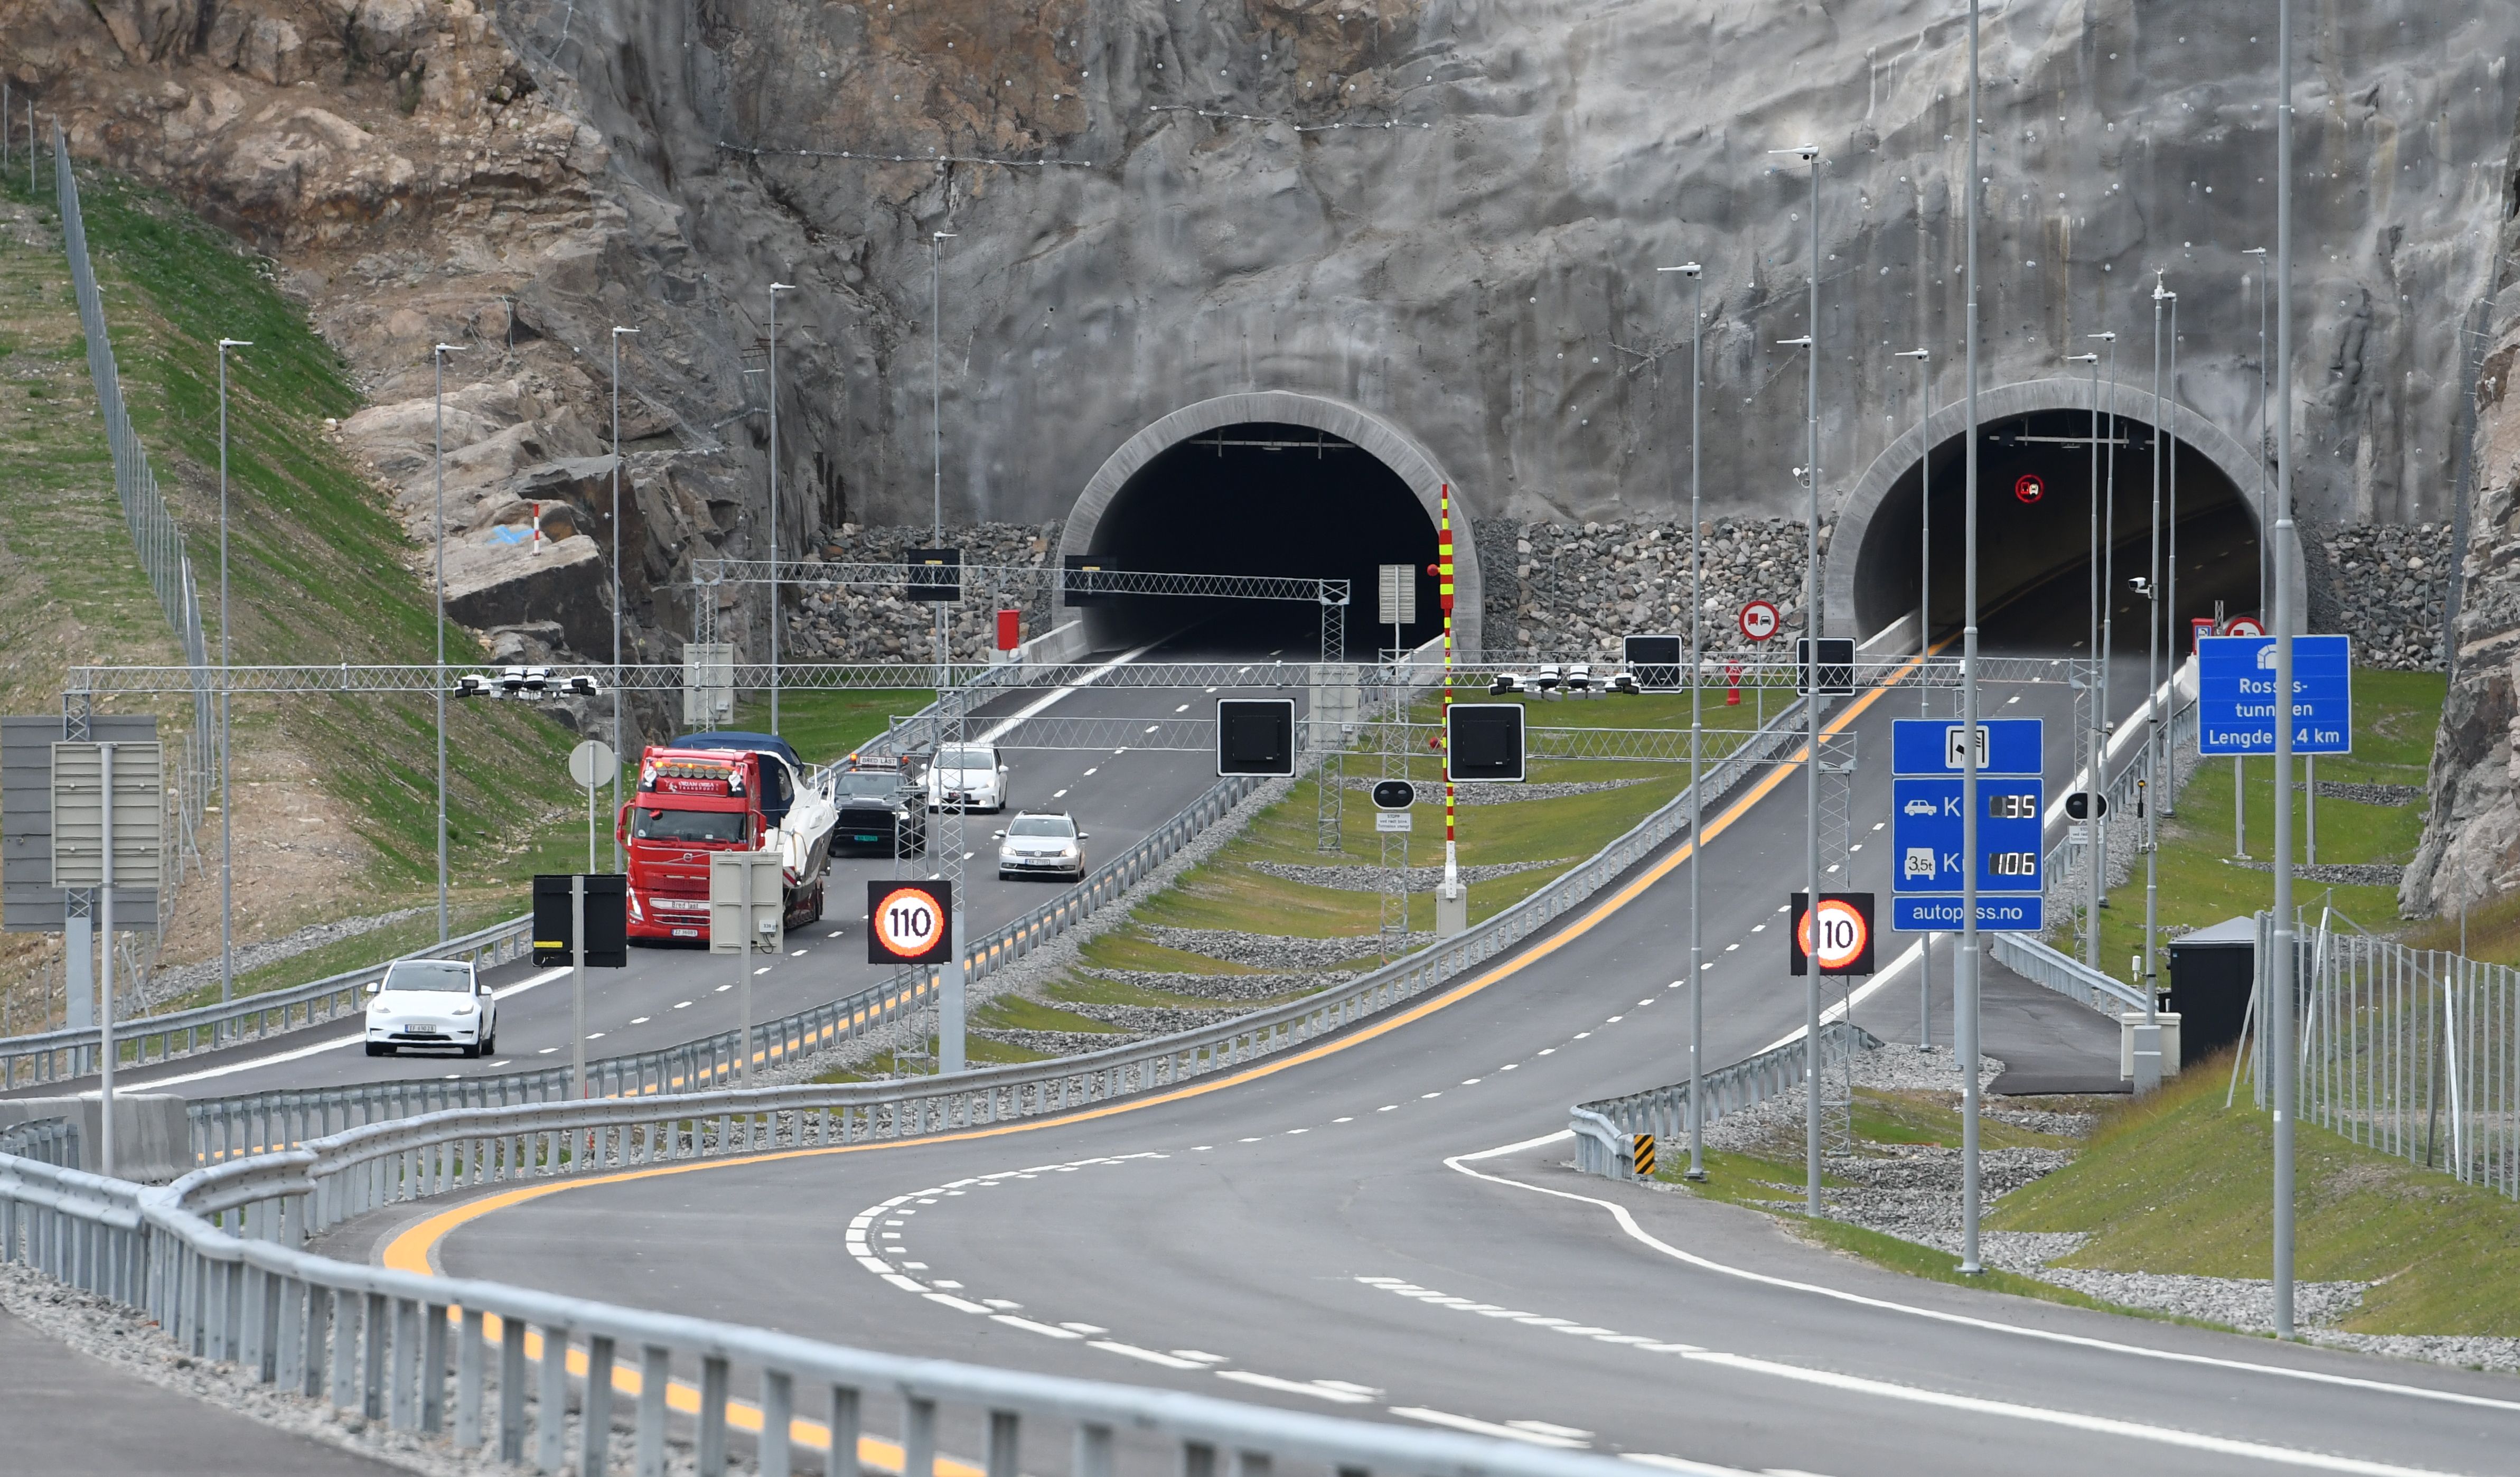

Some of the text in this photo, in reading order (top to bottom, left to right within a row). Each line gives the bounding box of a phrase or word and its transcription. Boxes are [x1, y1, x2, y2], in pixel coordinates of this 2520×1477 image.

[2239, 678, 2308, 694] Ross-
[2235, 703, 2312, 717] tunnen
[2209, 728, 2339, 748] Lengde ,4 km
[2006, 794, 2035, 819] 35
[1908, 855, 1933, 873] 3,5t
[1998, 852, 2035, 875] 106
[890, 907, 931, 938] 110
[1913, 904, 2022, 923] autopss.no
[1818, 920, 1853, 949] 10
